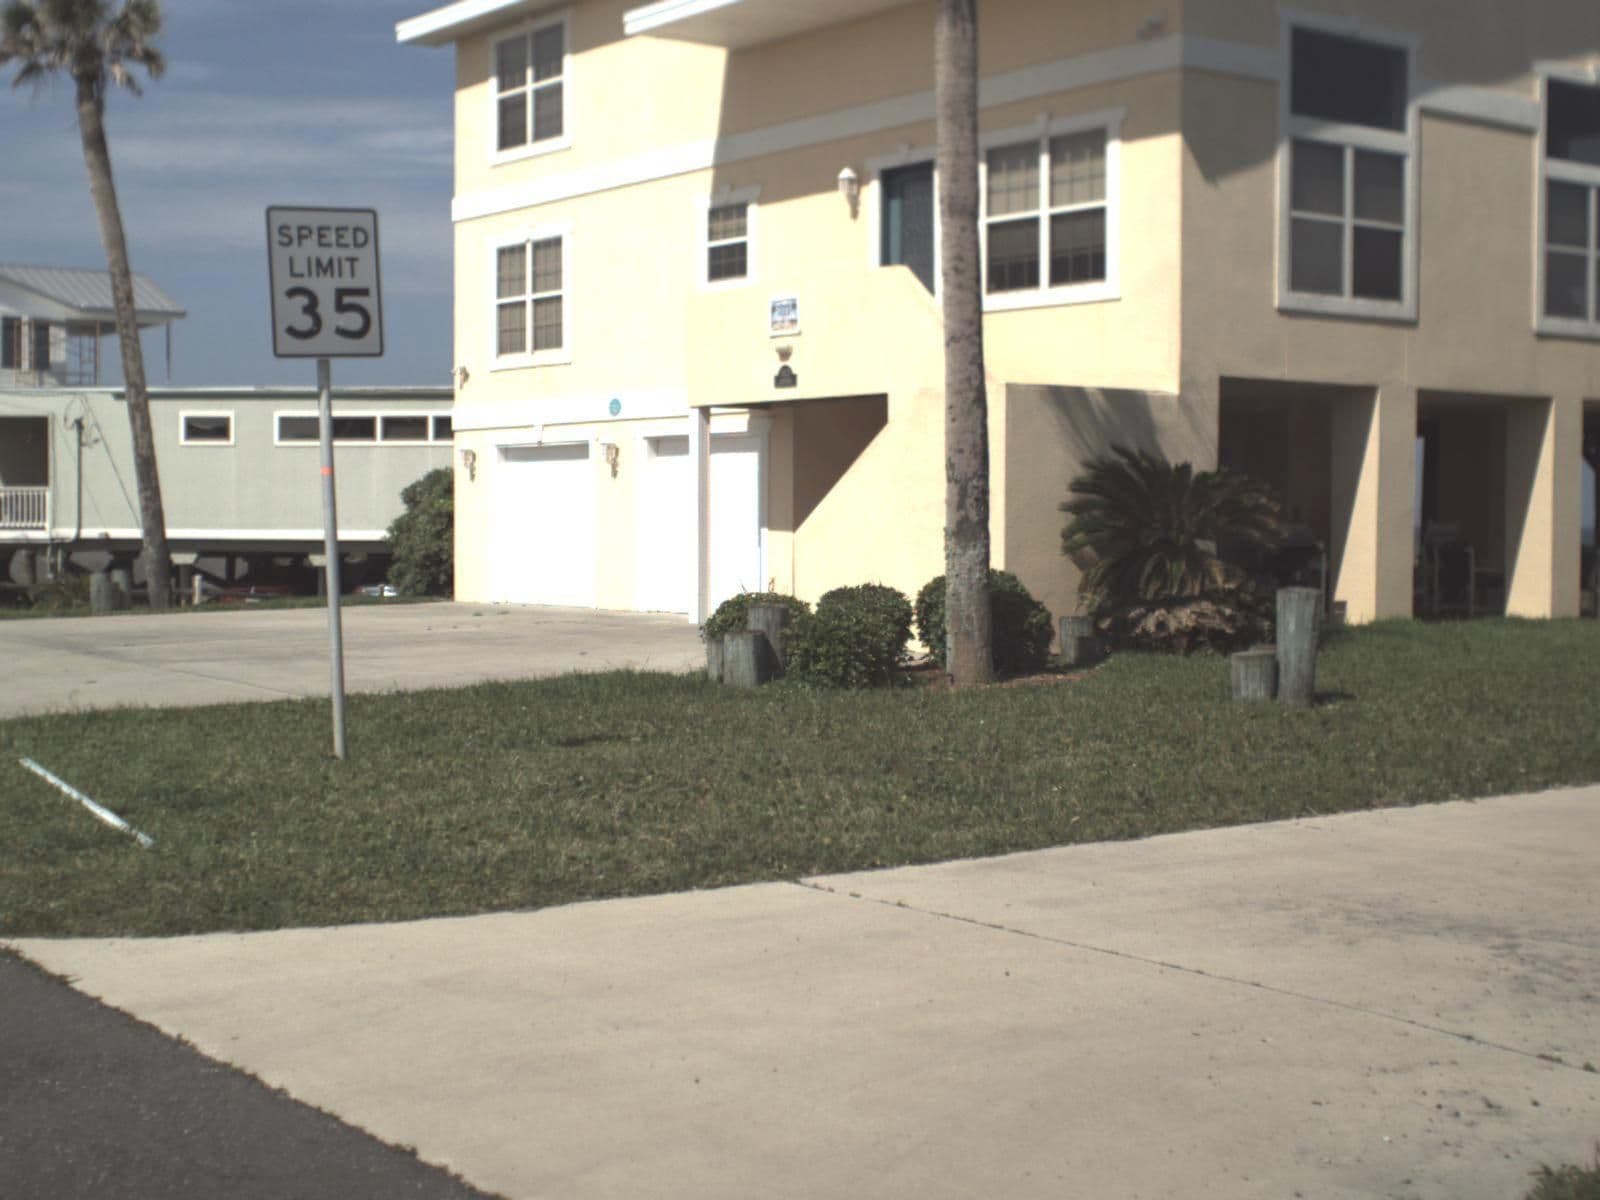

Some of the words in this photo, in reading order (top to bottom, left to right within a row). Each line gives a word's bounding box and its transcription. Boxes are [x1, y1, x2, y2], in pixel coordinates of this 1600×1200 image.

[278, 224, 369, 249] SPEED
[288, 256, 359, 279] LIMIT
[285, 286, 372, 340] 35
